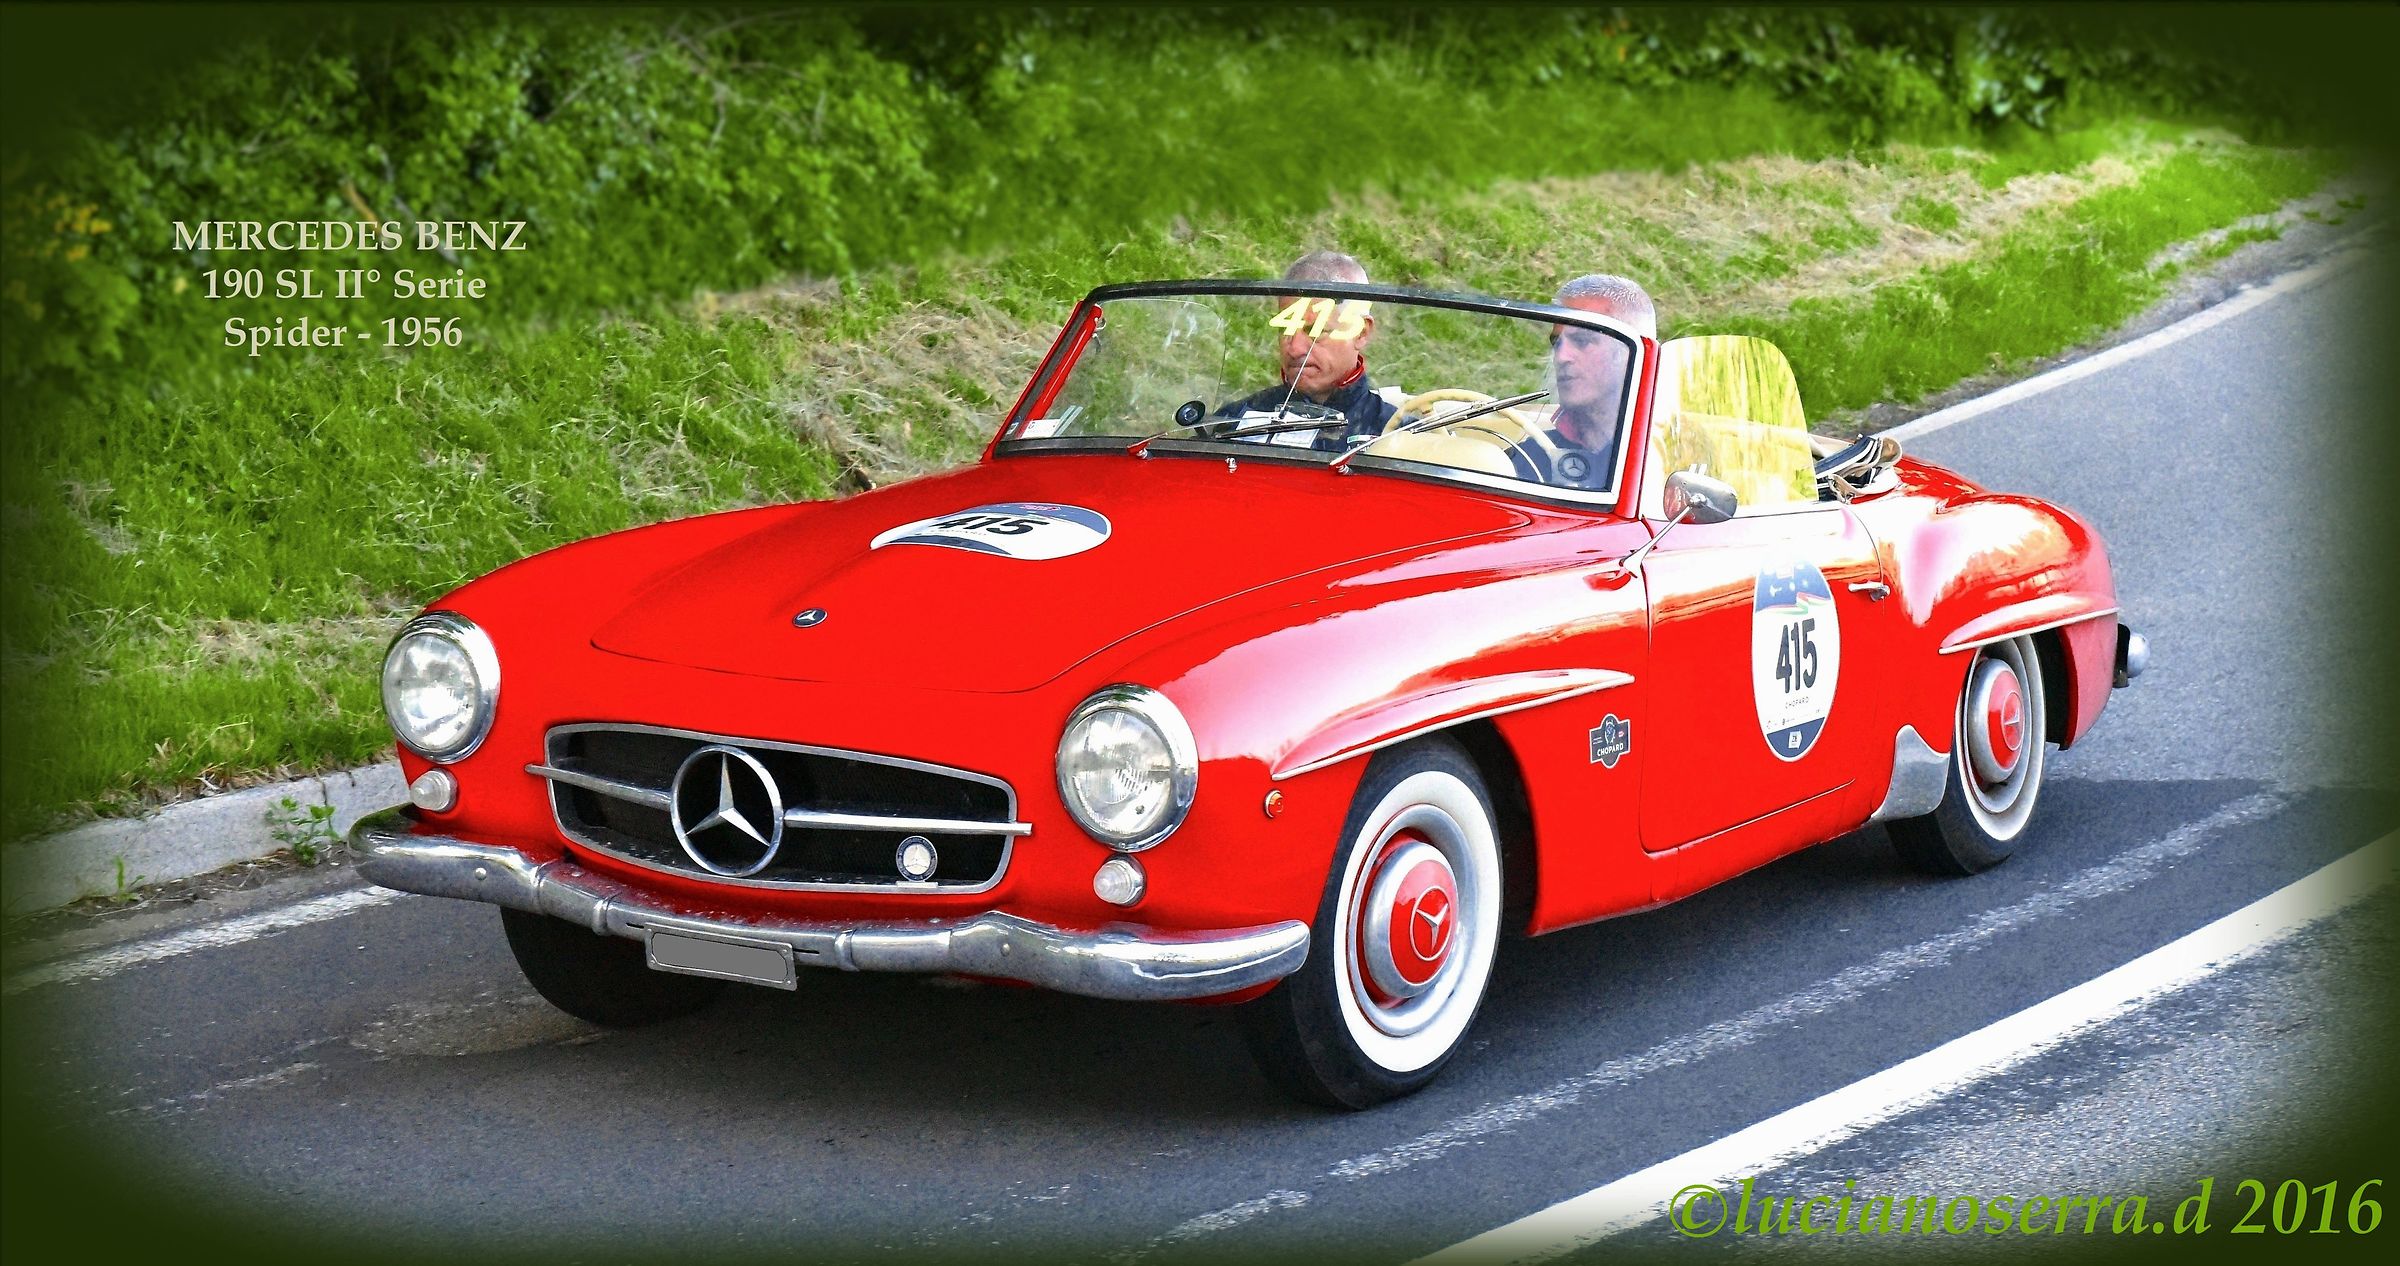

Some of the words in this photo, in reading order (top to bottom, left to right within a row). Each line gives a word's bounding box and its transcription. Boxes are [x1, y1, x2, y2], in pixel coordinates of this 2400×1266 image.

[1268, 297, 1373, 341] 415
[928, 515, 1051, 536] 415
[1775, 617, 1818, 694] 415
[1596, 742, 1624, 757] CHOPARD
